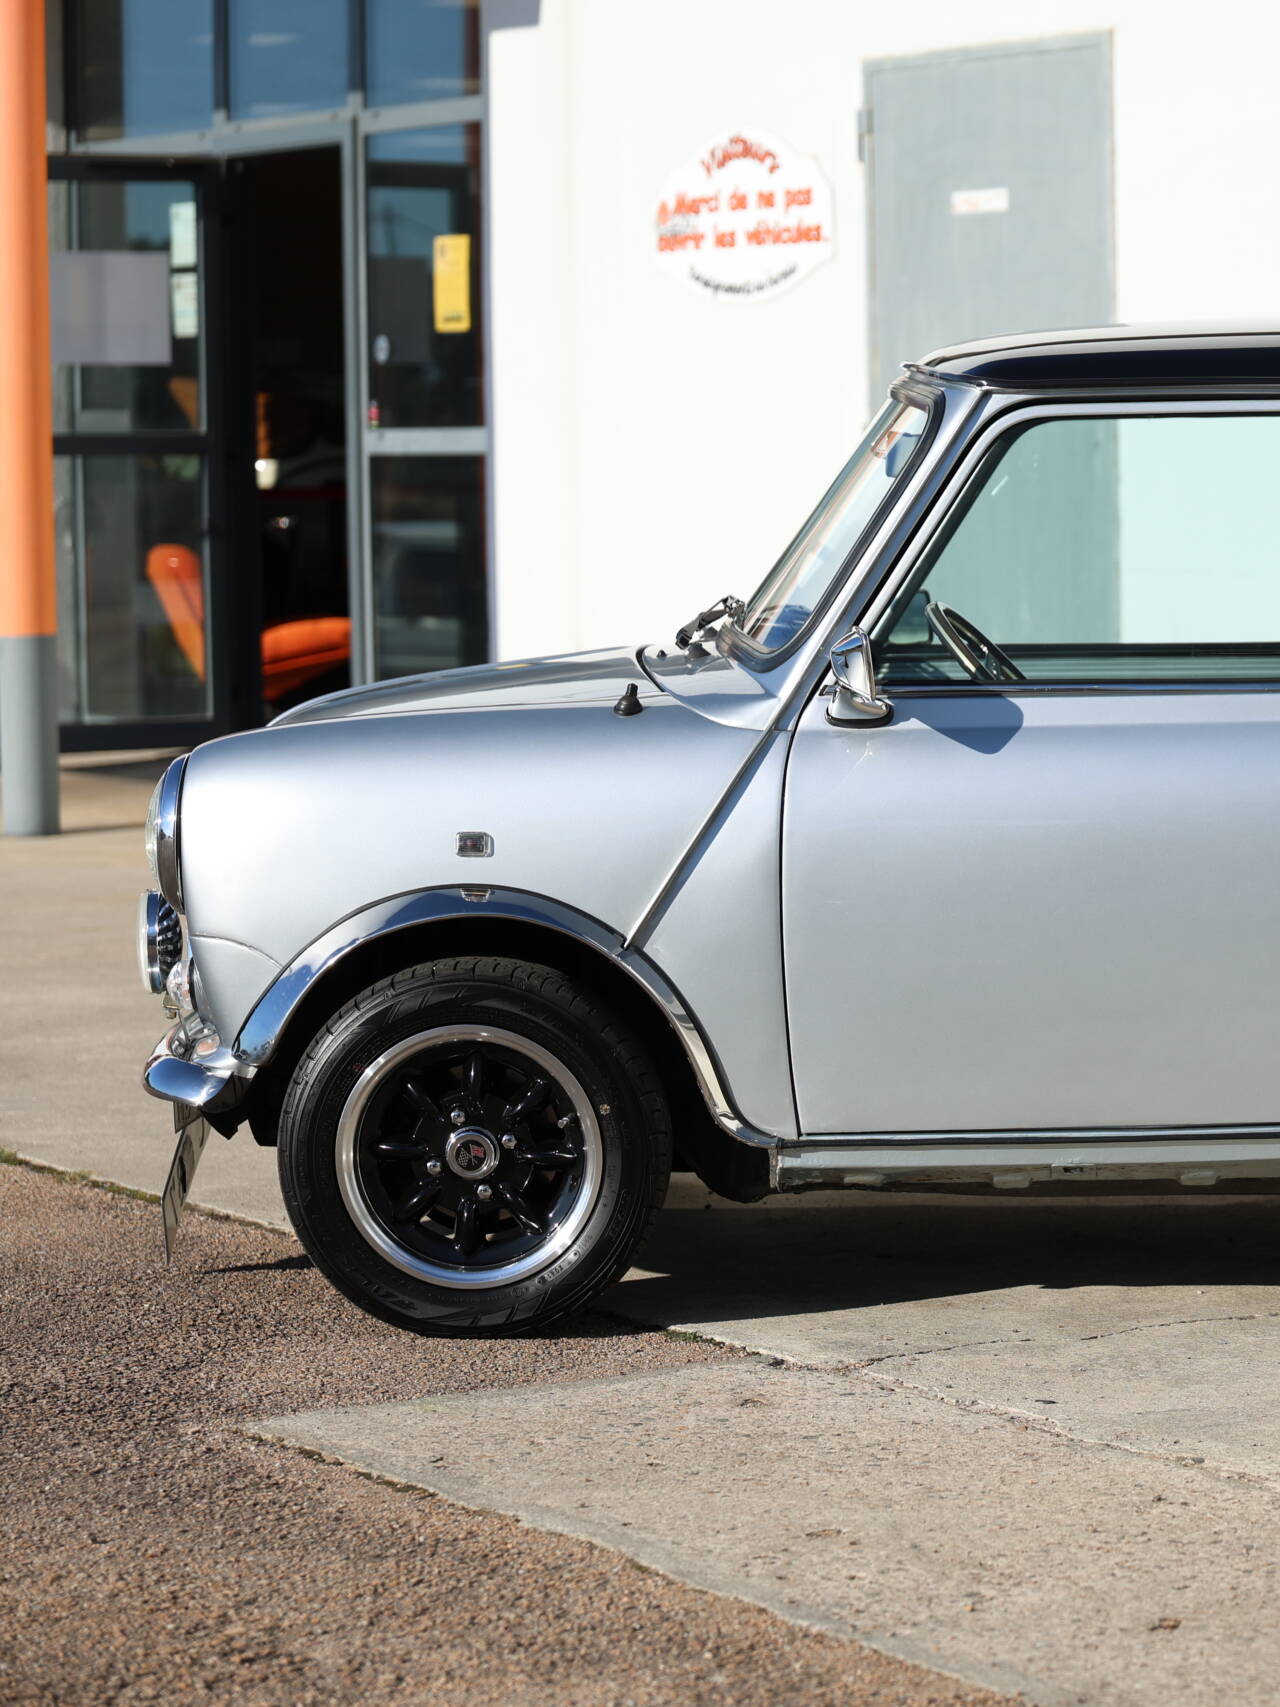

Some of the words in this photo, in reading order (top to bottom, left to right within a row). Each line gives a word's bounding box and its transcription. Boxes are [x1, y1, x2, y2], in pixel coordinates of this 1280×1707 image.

[673, 191, 720, 215] Merci
[728, 186, 748, 211] de
[756, 190, 776, 209] ne
[784, 186, 814, 214] pas
[713, 224, 737, 248] les
